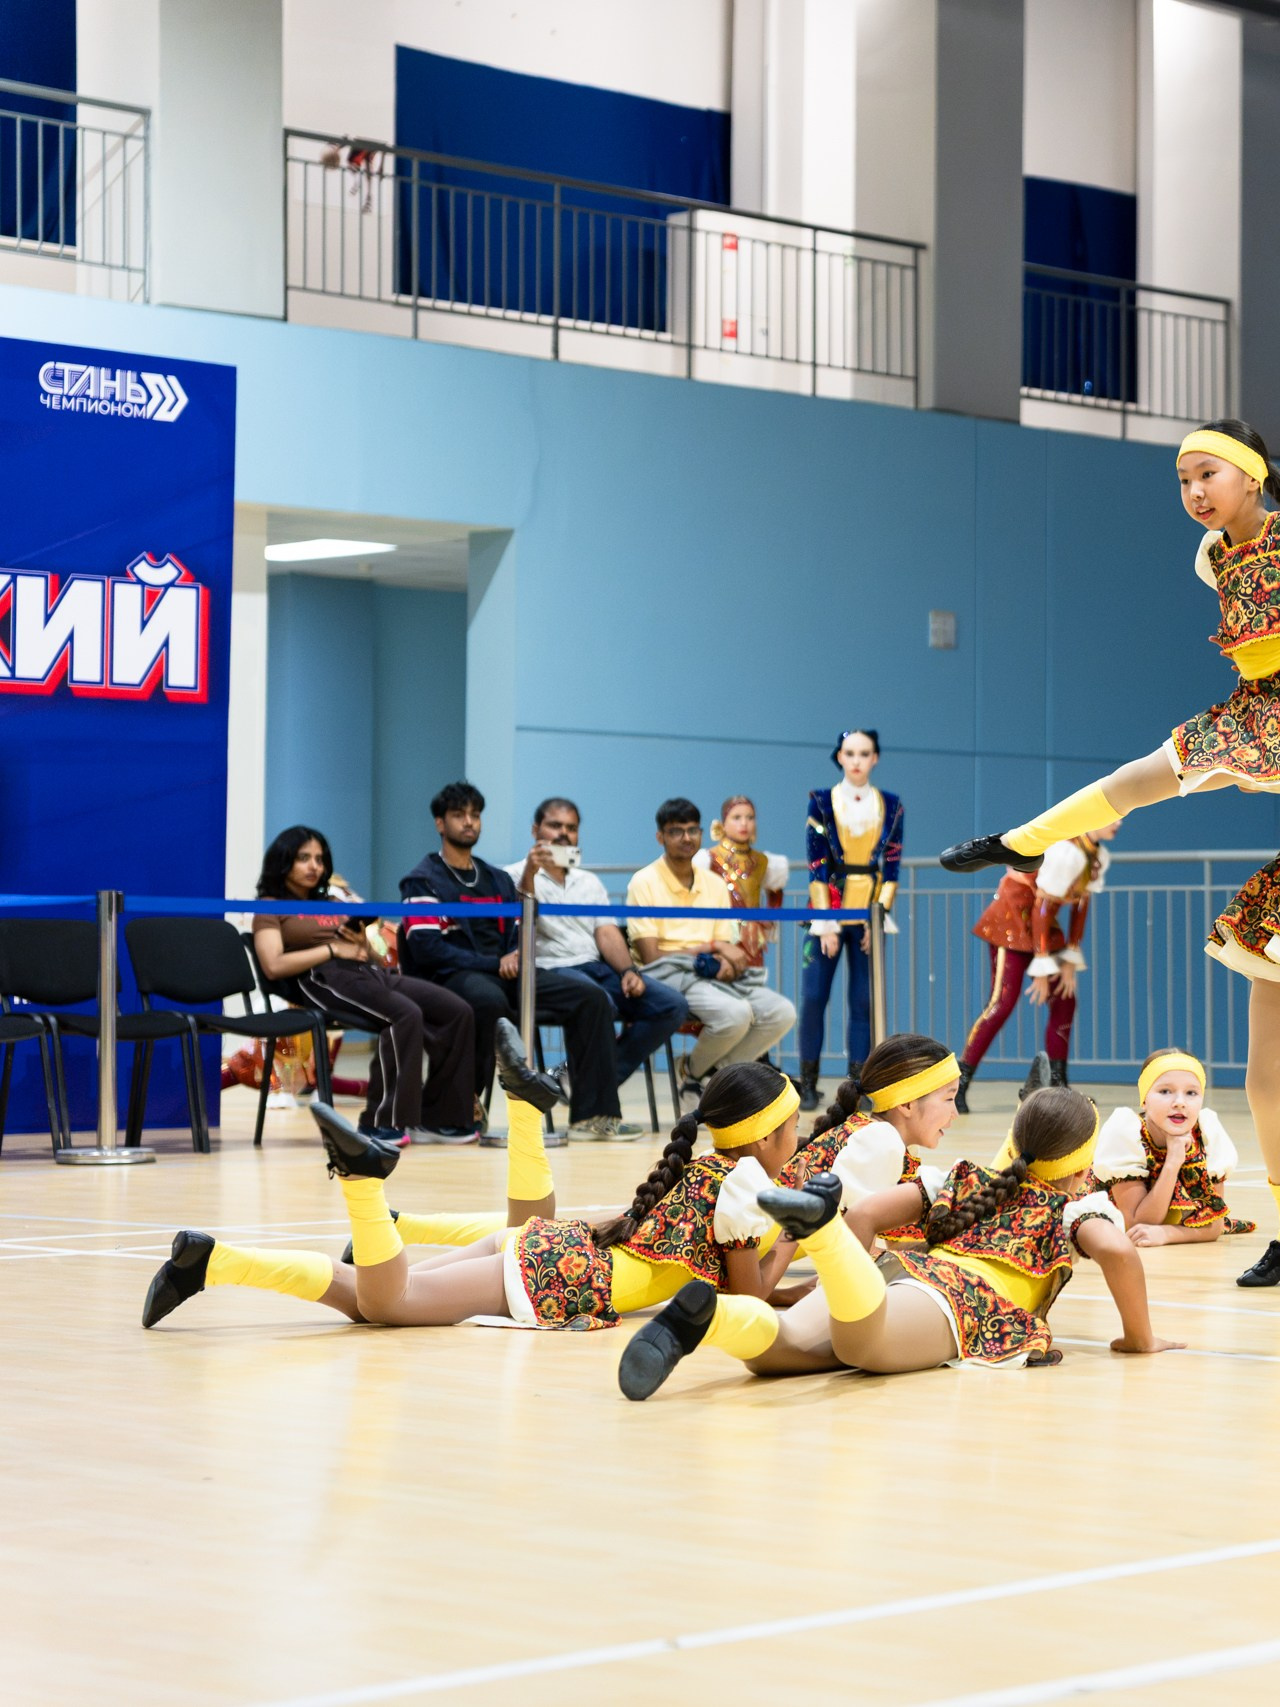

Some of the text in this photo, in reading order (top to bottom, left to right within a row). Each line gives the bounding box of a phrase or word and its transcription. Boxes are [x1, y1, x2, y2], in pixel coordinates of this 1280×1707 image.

[38, 360, 148, 405] СТАНЬ
[39, 393, 150, 420] ЧЕМПИОНОМ
[0, 551, 208, 702] ИЙ
